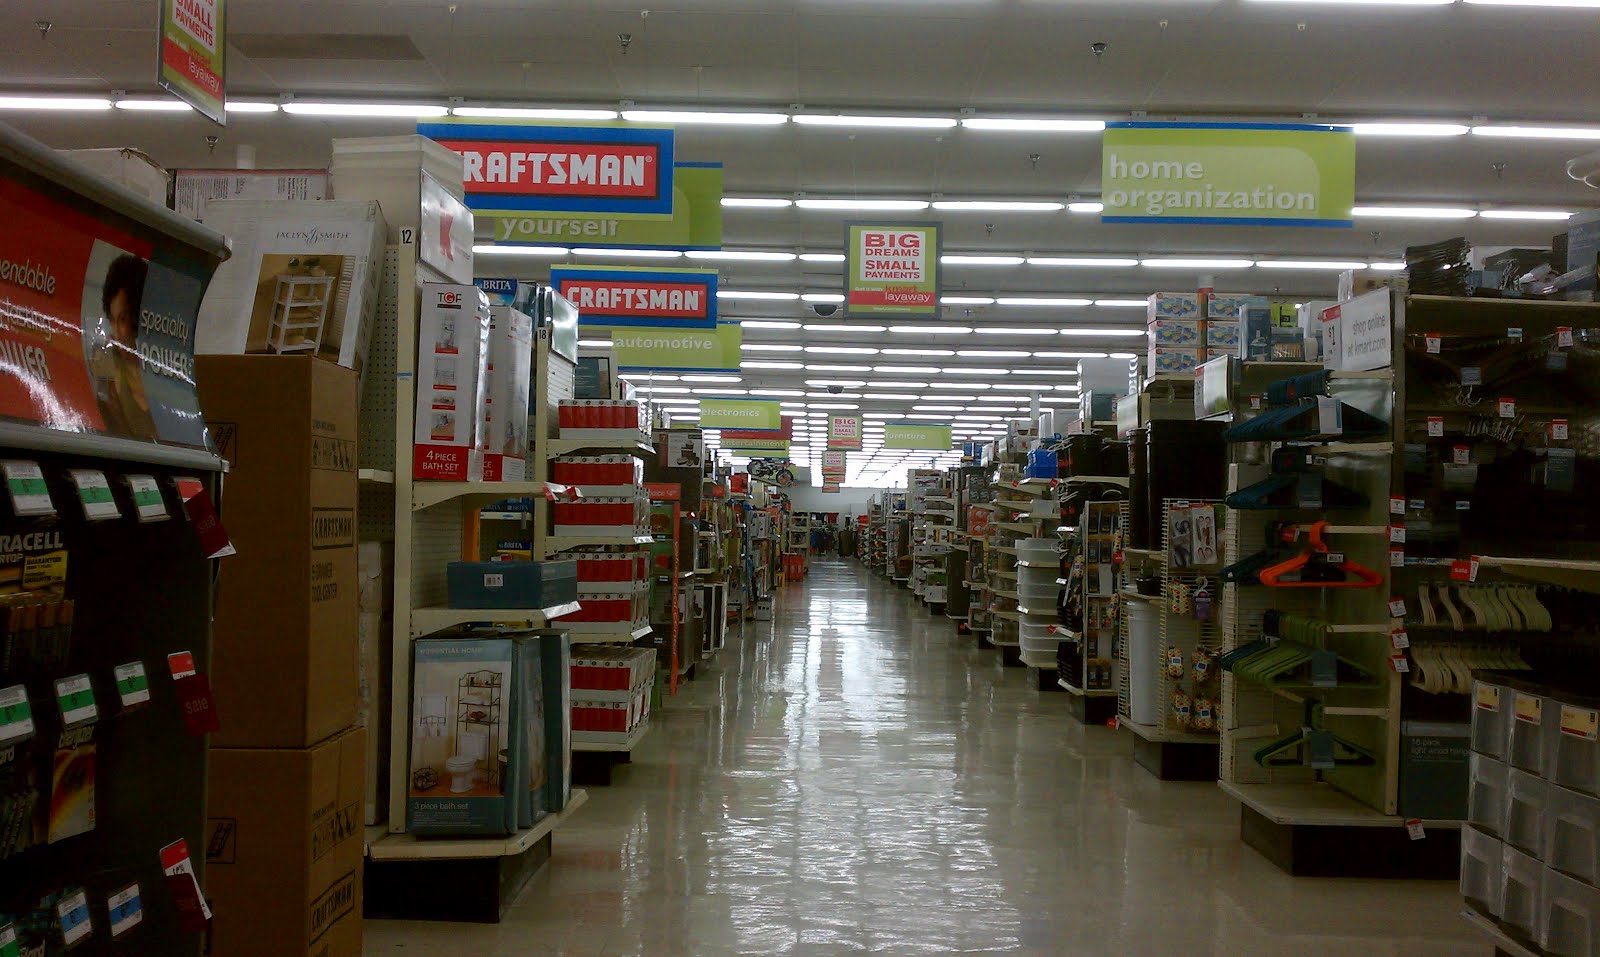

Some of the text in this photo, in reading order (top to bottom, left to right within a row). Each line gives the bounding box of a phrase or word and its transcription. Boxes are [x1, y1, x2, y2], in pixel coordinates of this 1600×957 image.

[175, 7, 213, 47] PAYMENTS
[188, 55, 221, 93] layaway
[454, 151, 645, 187] RAFTSMAN
[1110, 154, 1203, 179] home
[1109, 184, 1315, 215] organization
[276, 231, 308, 240] JACLYN
[320, 232, 350, 240] SMITH
[402, 229, 412, 244] 12
[501, 218, 620, 240] yourself
[865, 233, 920, 248] BIG
[865, 248, 920, 257] DREAMS
[865, 260, 920, 271] SMALL
[0, 258, 56, 295] endable
[865, 271, 920, 279] PAYMENTS
[483, 280, 511, 290] BRITA
[568, 286, 699, 311] CRAFTSMAN
[884, 292, 931, 303] layaway
[140, 310, 189, 346] specialty
[1352, 313, 1386, 336] shop online
[538, 329, 546, 340] 18
[614, 335, 713, 350] automotive
[701, 407, 760, 417] electronics
[885, 431, 926, 440] furniture
[426, 450, 457, 462] 4 PIECE
[422, 462, 459, 471] BATH SET
[503, 541, 523, 550] BRITA
[185, 696, 209, 715] sale
